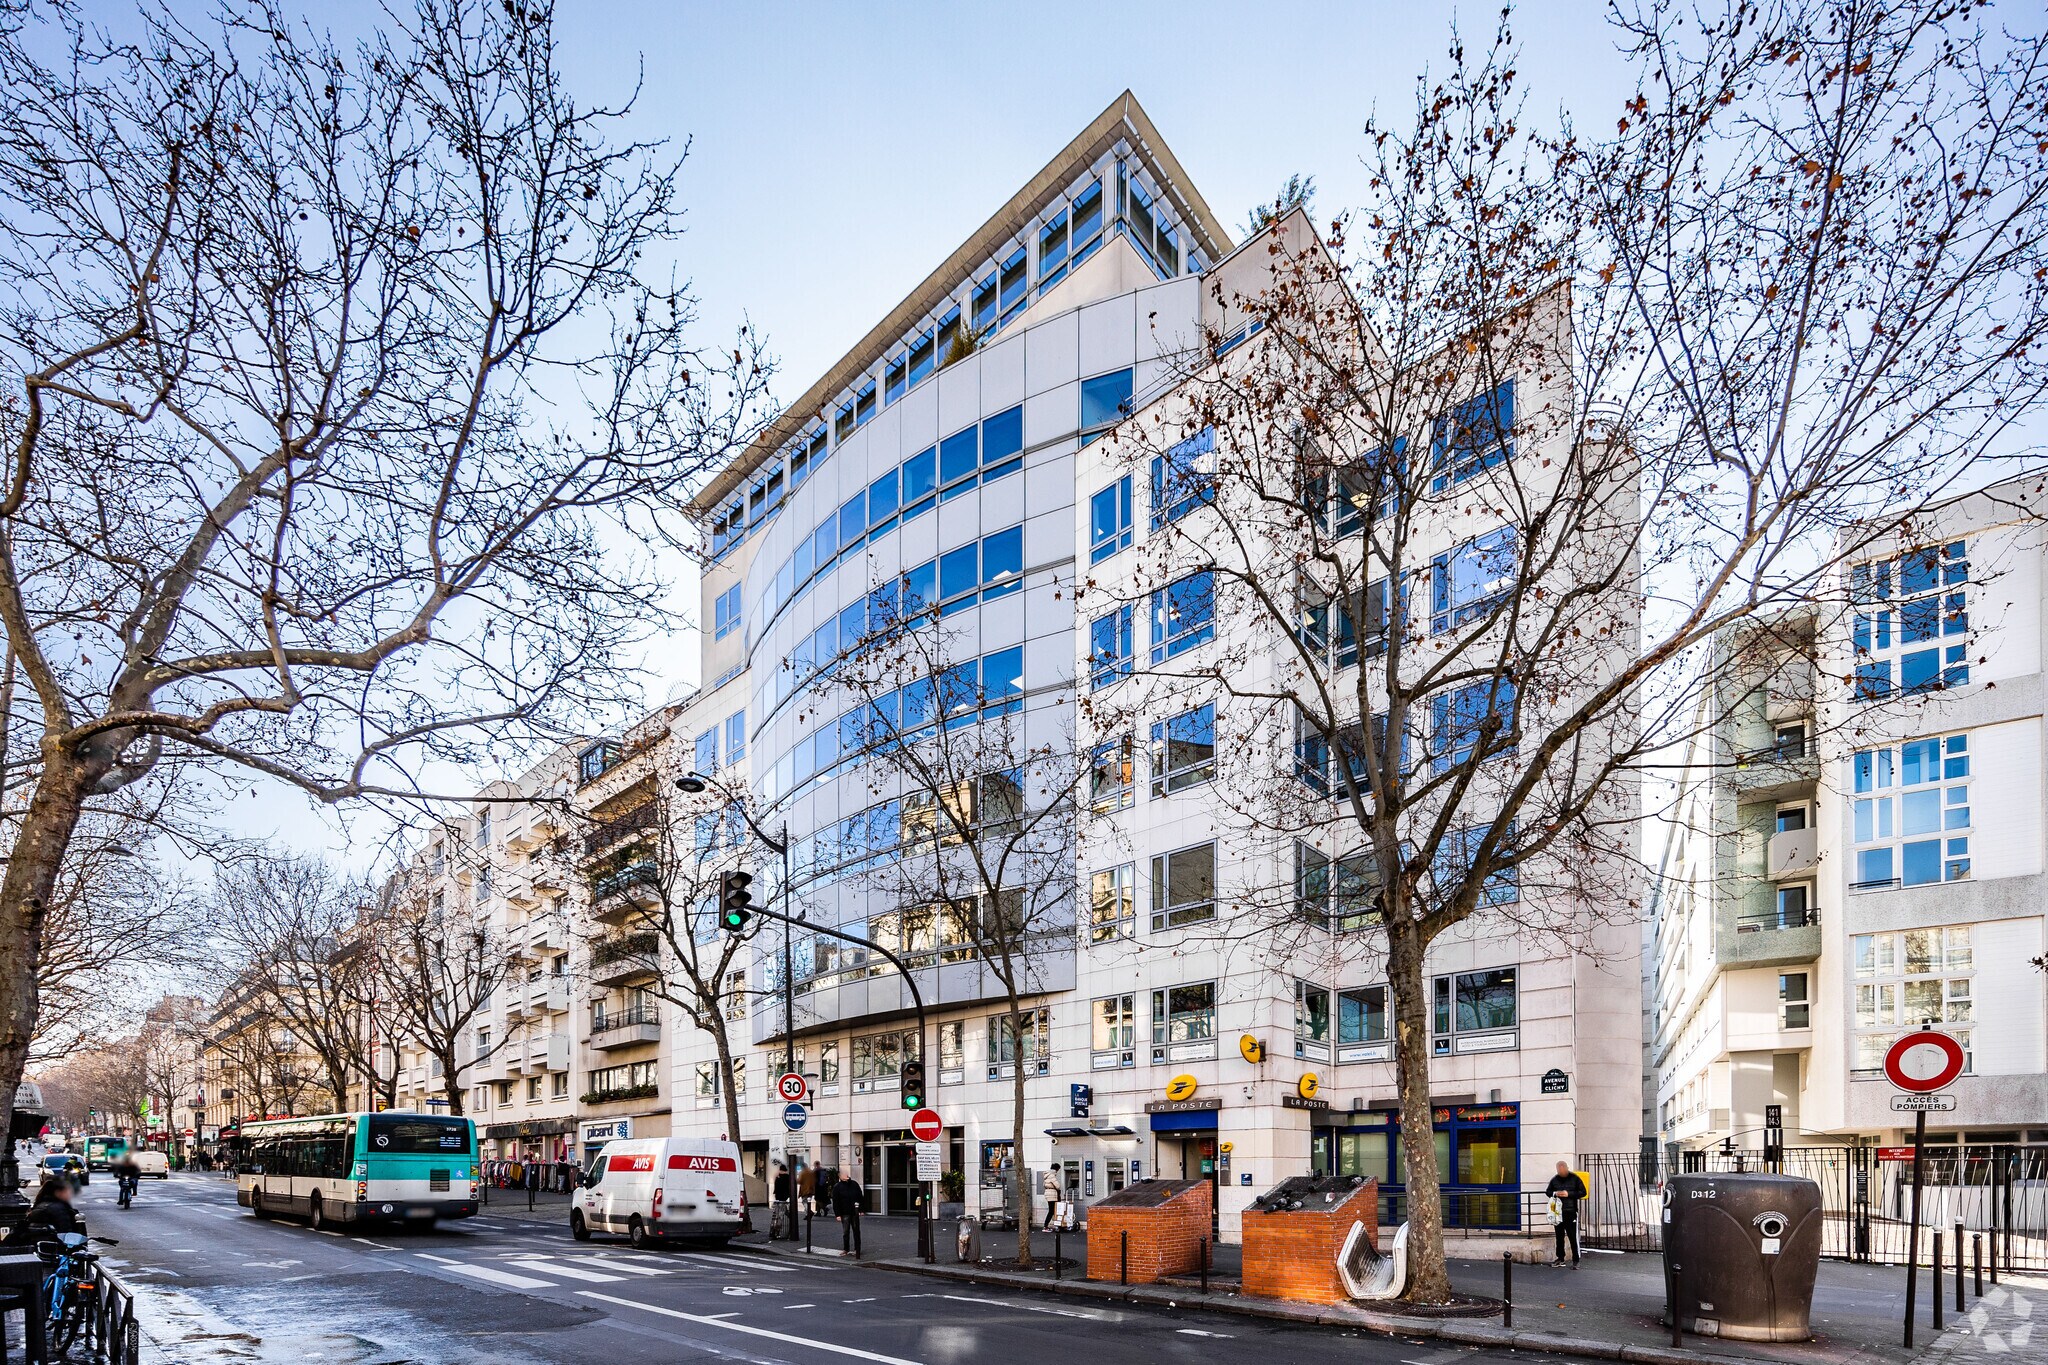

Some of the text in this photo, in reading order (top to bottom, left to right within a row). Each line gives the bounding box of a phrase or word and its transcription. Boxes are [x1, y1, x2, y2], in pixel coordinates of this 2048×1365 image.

[784, 1081, 801, 1094] 30
[1150, 1101, 1213, 1110] LA POSTE
[1304, 1100, 1326, 1108] POSTE
[1768, 1108, 1778, 1116] 141
[1768, 1117, 1780, 1126] 143
[587, 1124, 614, 1138] picard
[632, 1157, 650, 1170] AVIS
[688, 1157, 720, 1170] AVIS
